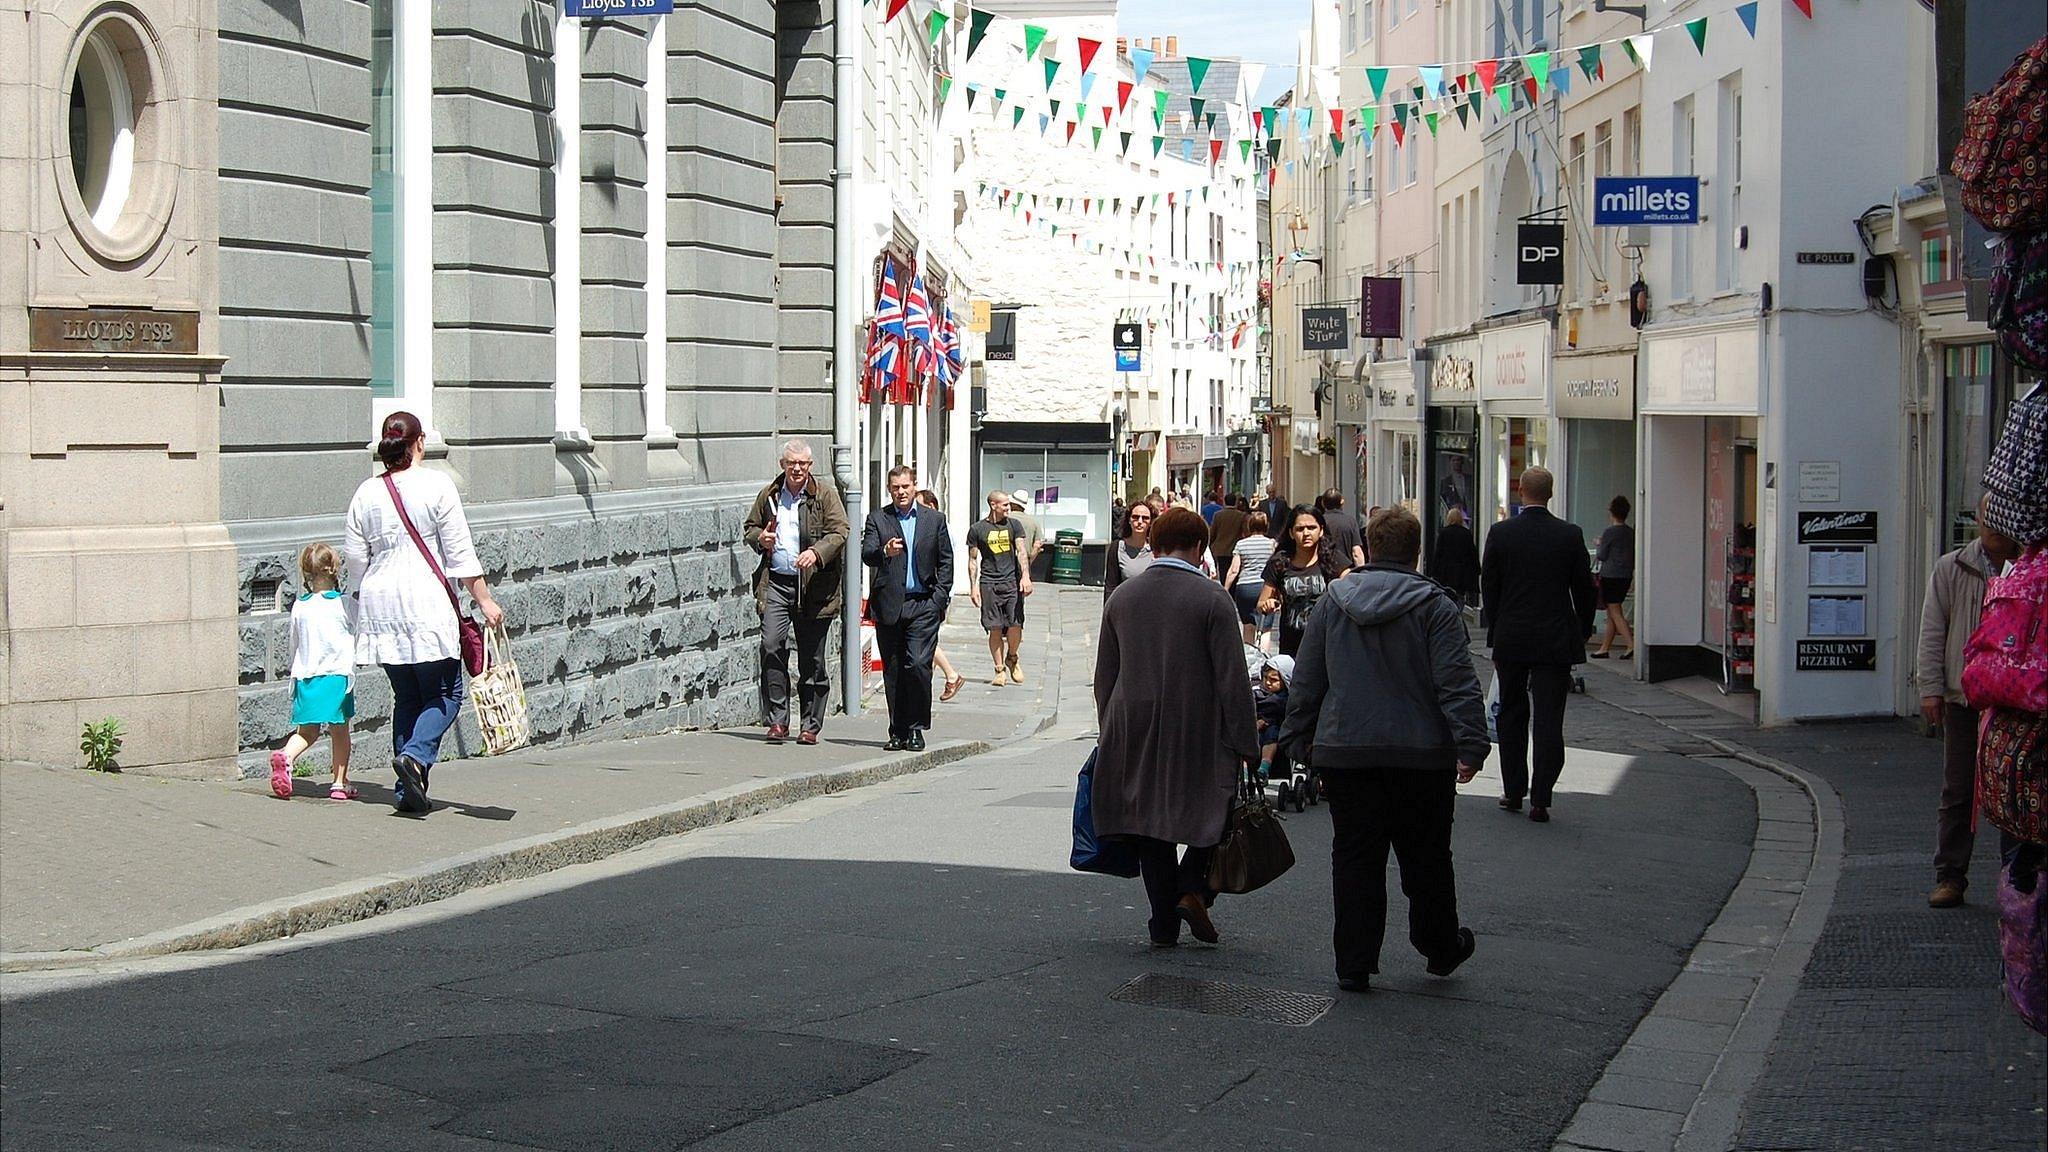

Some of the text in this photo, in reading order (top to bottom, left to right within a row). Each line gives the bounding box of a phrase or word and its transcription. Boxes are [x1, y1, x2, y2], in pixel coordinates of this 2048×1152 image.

[582, 0, 655, 12] Lloyds TSB
[1601, 185, 1690, 211] millets
[1643, 213, 1690, 221] millets.co.uk
[1522, 246, 1560, 262] DP
[1800, 254, 1852, 263] LE POLLET
[63, 319, 176, 343] LLOYDS TSB
[1802, 513, 1867, 535] Valentinos
[1799, 643, 1865, 654] RESTAURANT
[1799, 656, 1847, 666] PIZZERIA
